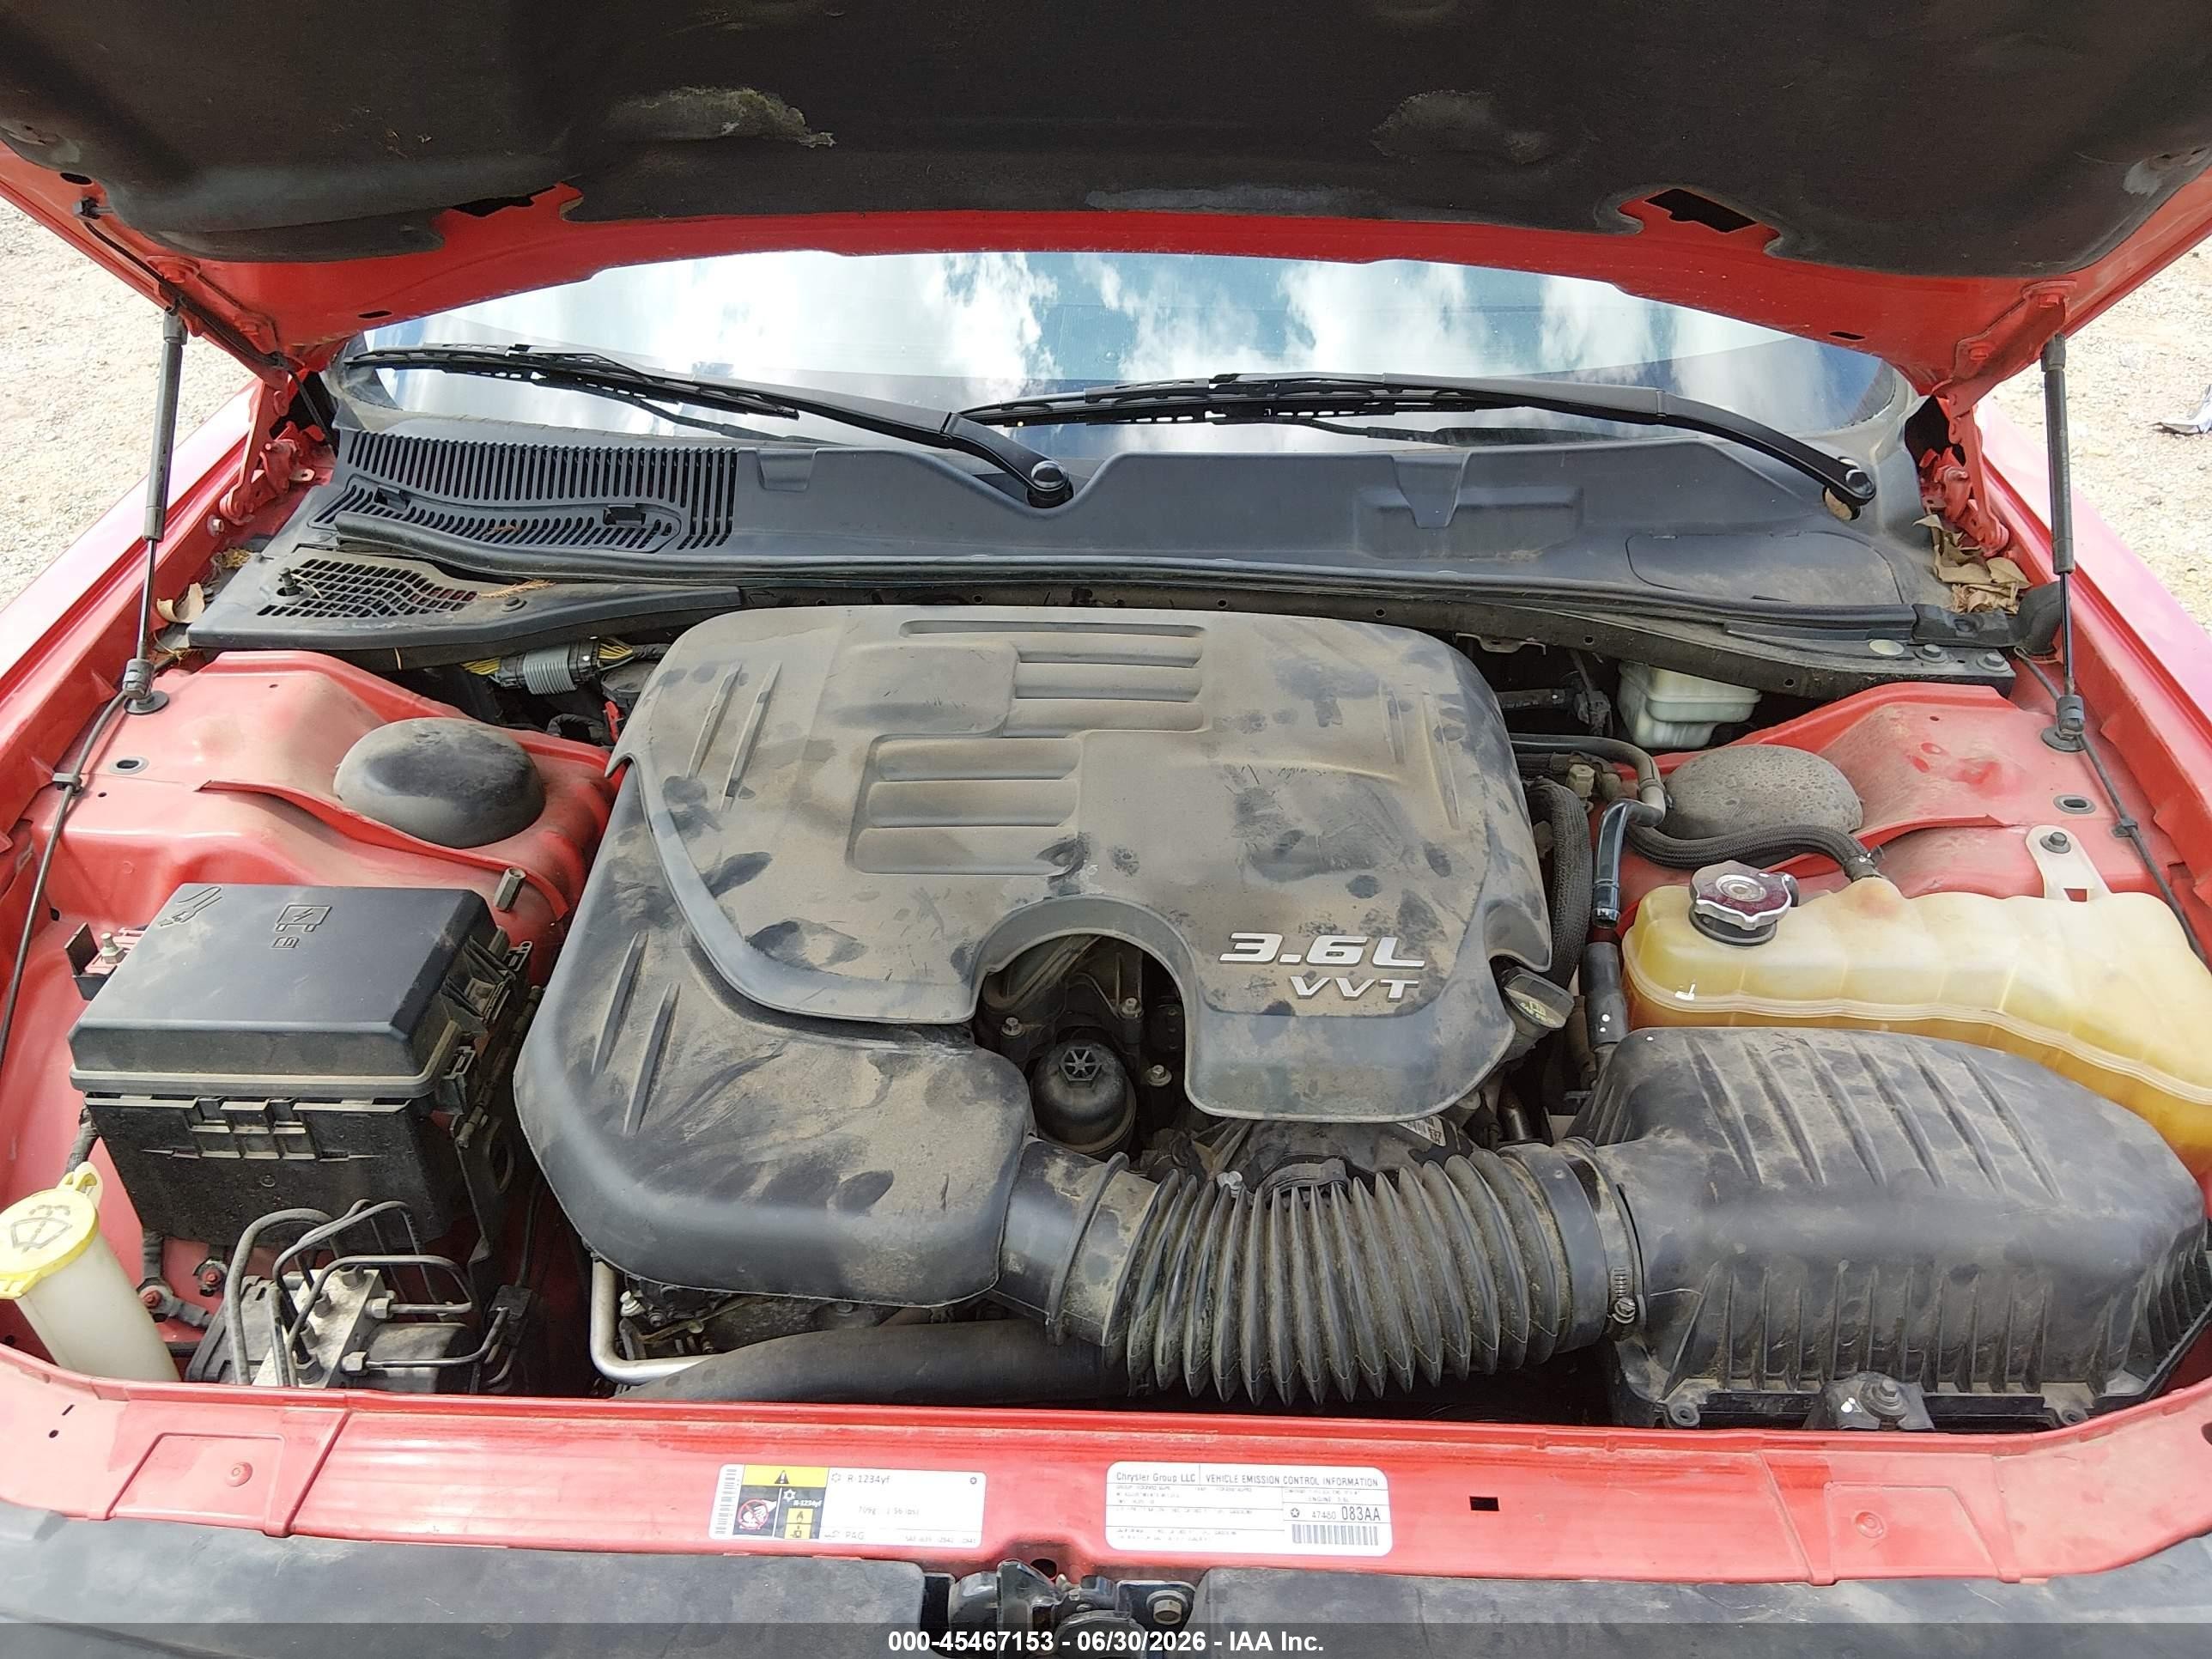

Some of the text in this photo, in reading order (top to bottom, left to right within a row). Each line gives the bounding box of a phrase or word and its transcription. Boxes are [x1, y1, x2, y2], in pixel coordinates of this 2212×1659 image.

[1218, 933, 1425, 969] 3.6L
[1290, 975, 1419, 1002] VVT
[1116, 1472, 1196, 1484] Chrysler Group LLC
[1206, 1474, 1378, 1486] VEHICLE EMISSION CONTROL INFORMATION
[1341, 1505, 1382, 1522] 083AA
